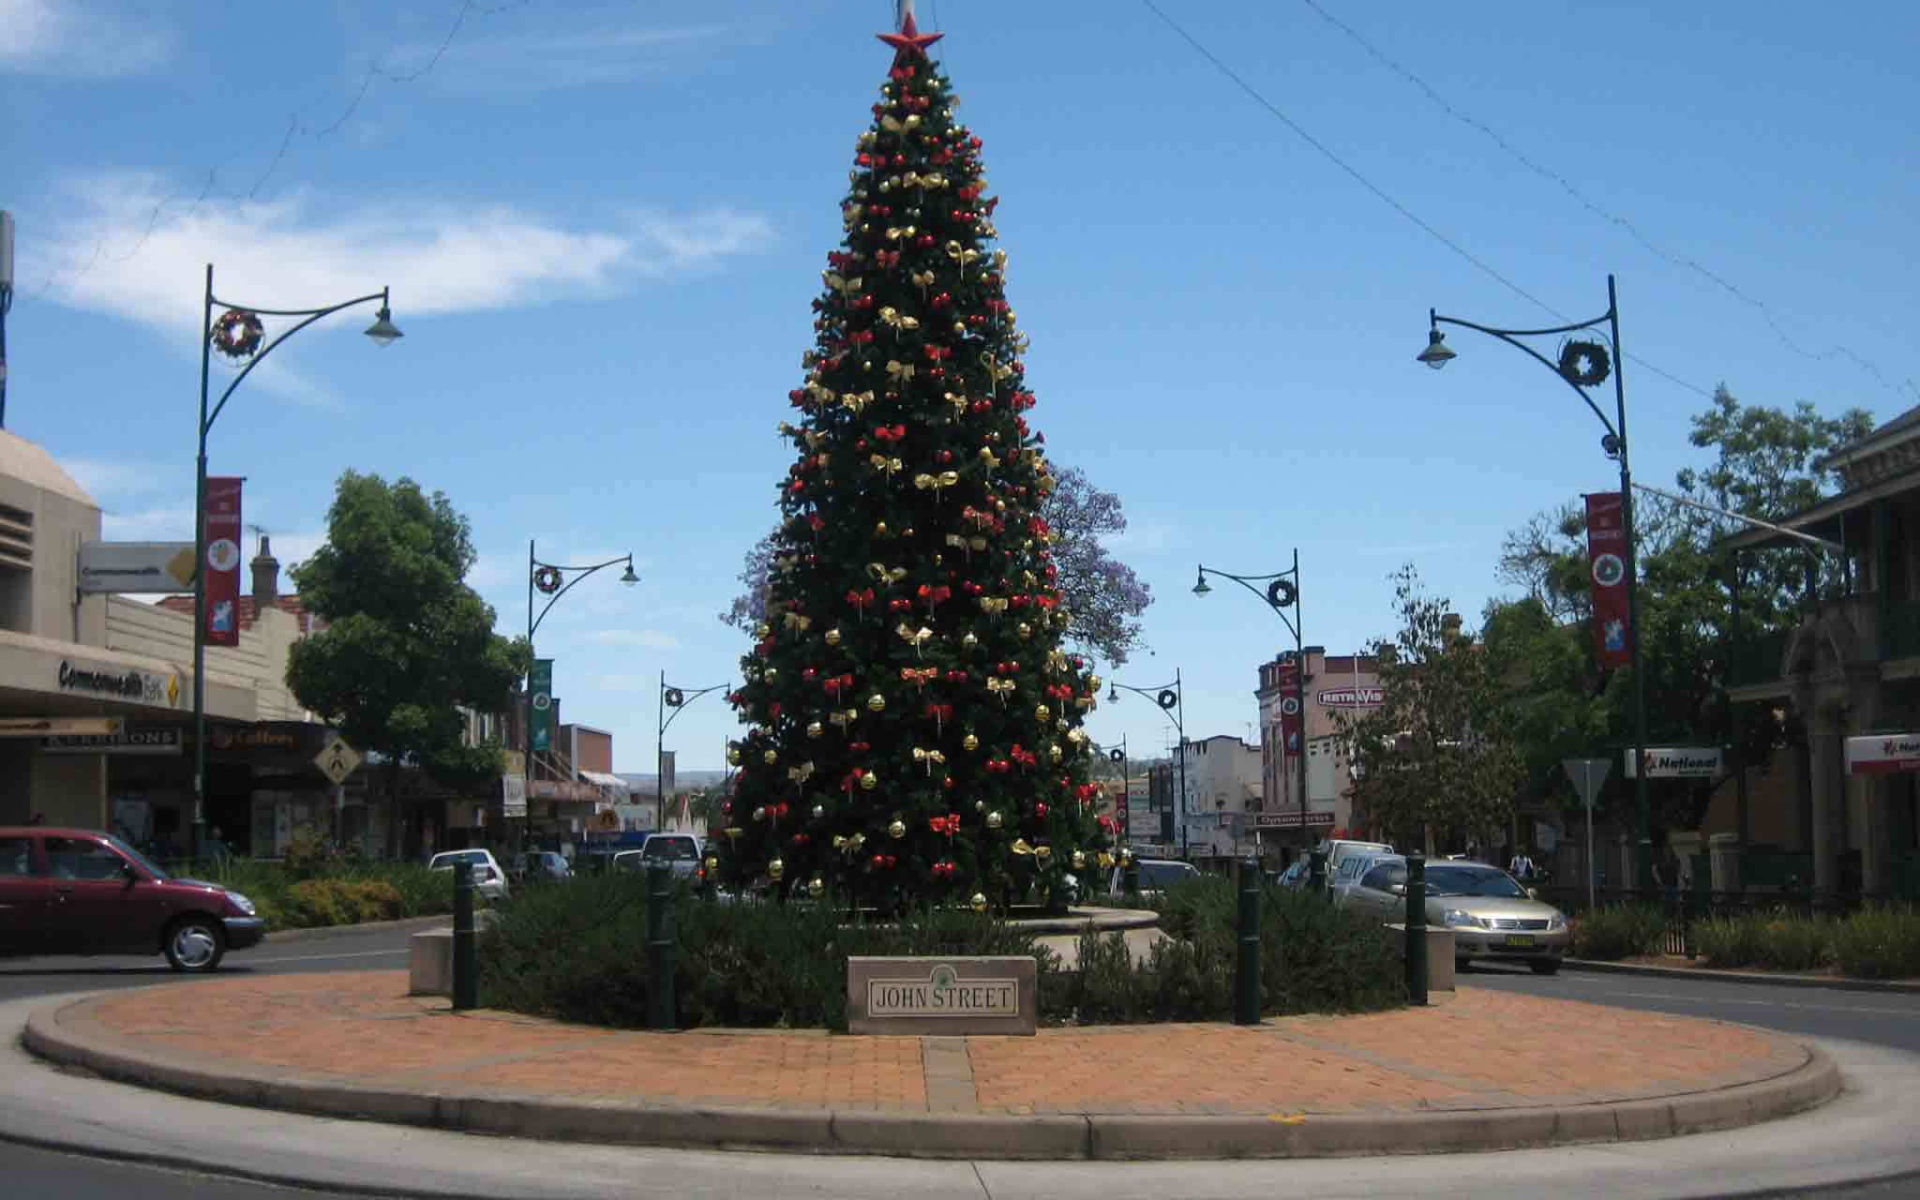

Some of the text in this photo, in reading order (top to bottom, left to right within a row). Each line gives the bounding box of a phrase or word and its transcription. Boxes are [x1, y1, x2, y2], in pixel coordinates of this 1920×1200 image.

[1659, 757, 1718, 769] National
[876, 987, 1012, 1008] JOHN STREET
